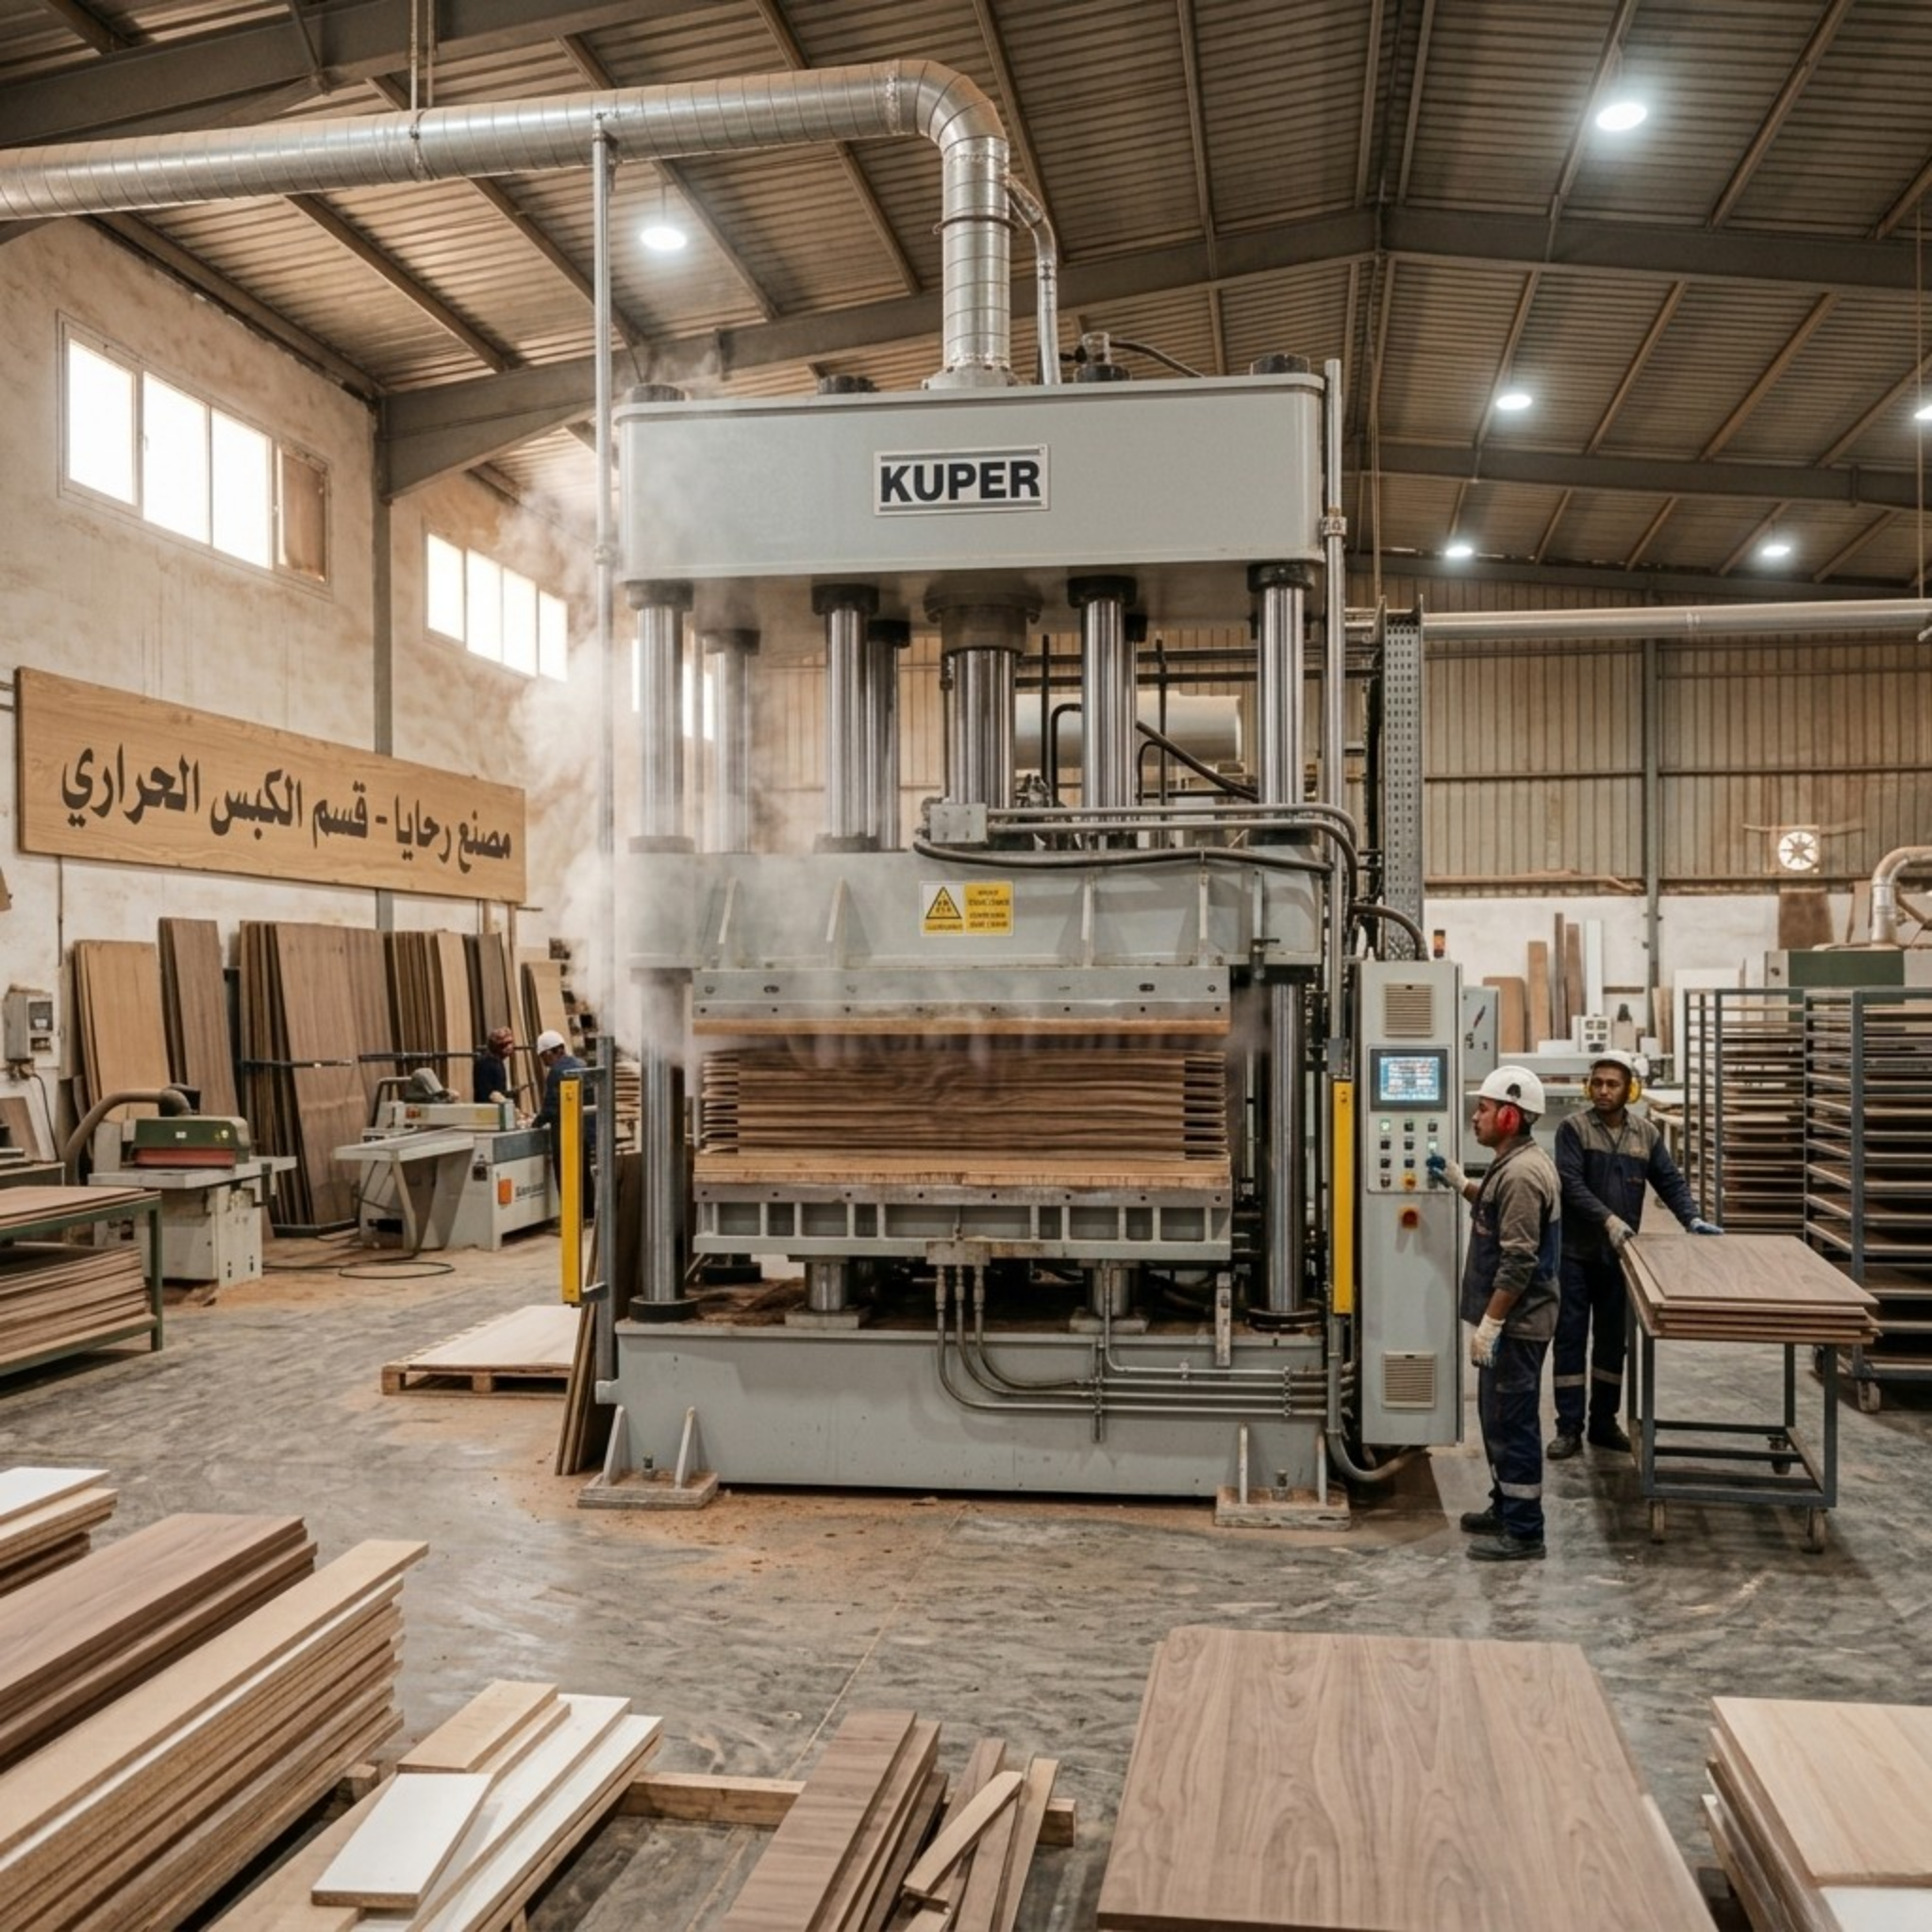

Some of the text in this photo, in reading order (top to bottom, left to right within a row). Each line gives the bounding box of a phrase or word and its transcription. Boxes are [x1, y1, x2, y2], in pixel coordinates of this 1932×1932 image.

[880, 459, 1041, 503] KUPER
[61, 741, 200, 828] الحراري
[209, 769, 302, 841] الكبس
[312, 780, 368, 849] قسم
[394, 793, 451, 864] رحايا
[458, 809, 511, 874] مصنع
